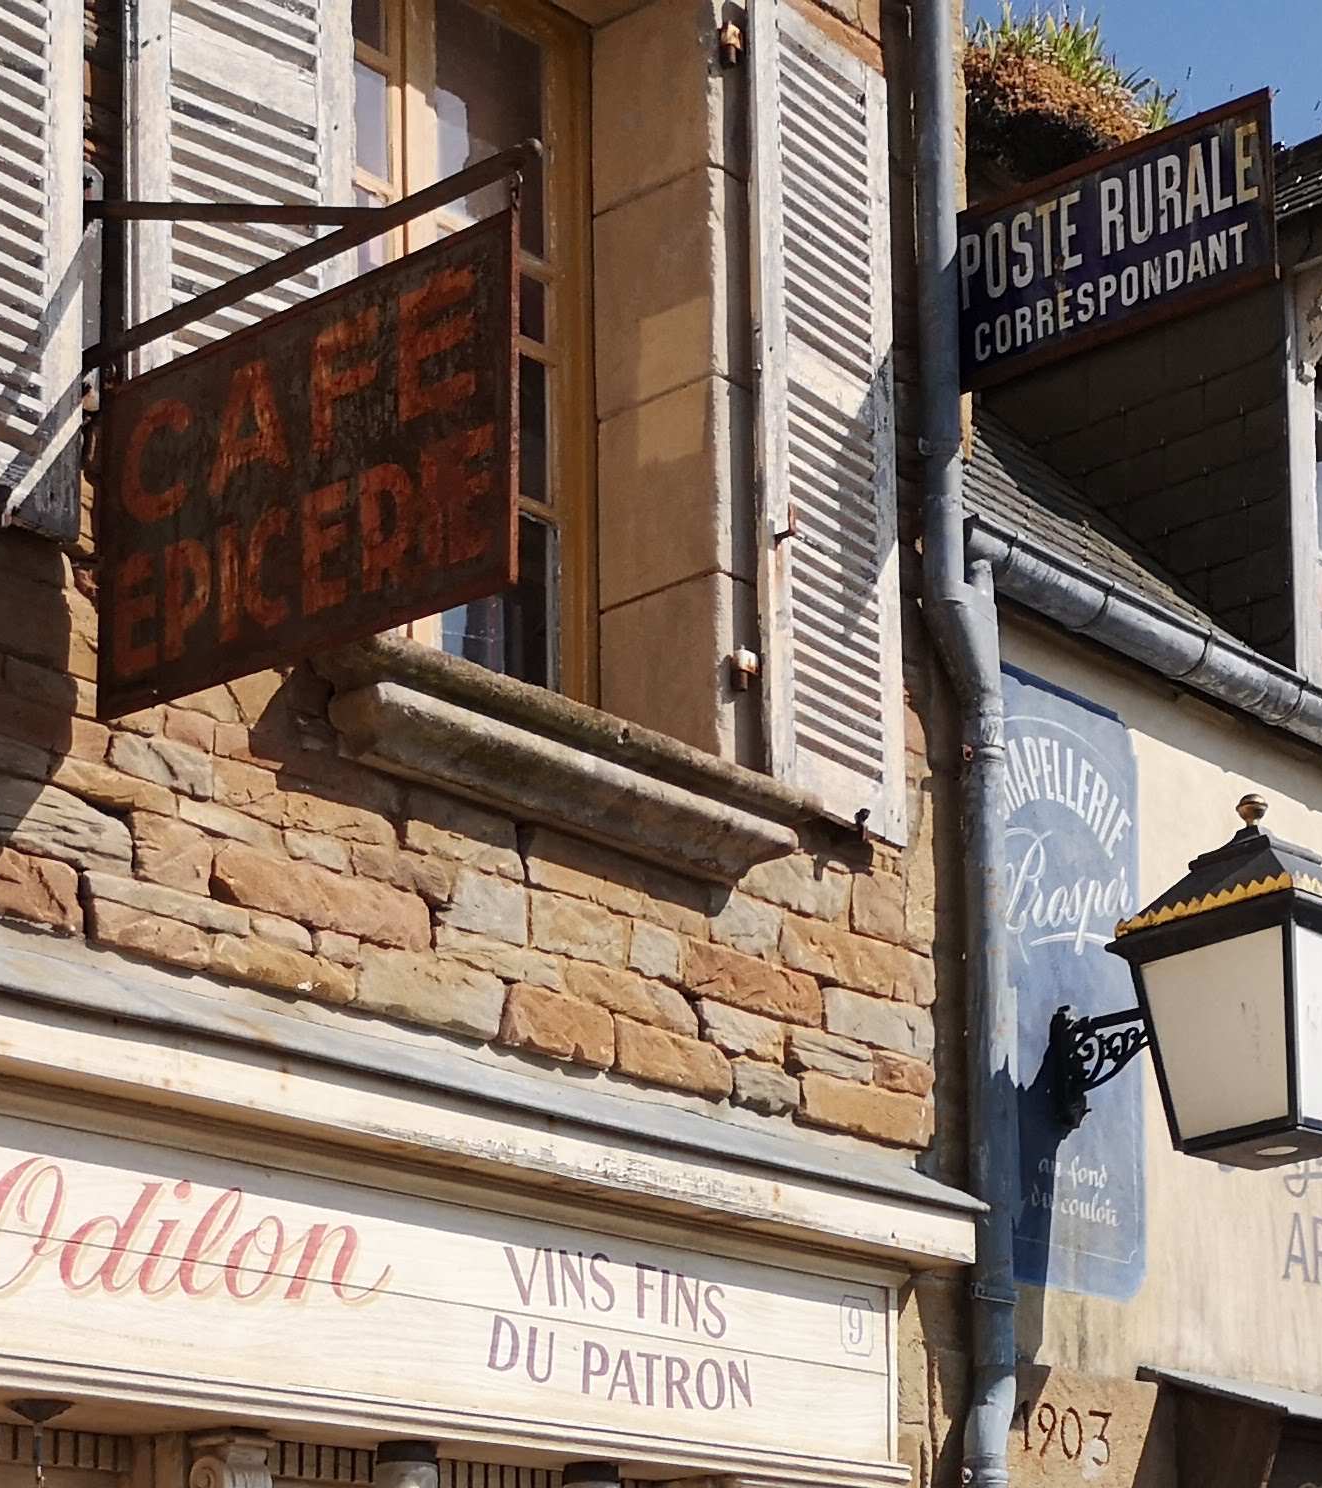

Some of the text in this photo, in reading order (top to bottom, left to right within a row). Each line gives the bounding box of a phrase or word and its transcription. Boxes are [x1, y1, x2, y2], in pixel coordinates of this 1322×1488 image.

[960, 121, 1259, 310] POSTE RURALE
[975, 222, 1248, 361] CORRESPONDANT
[997, 736, 1132, 859] HAPELLERIE
[1068, 1156, 1108, 1189] fond
[503, 1246, 728, 1340] VINS FINS
[846, 1306, 865, 1346] 9
[488, 1314, 754, 1411] DU PATRON
[1014, 1400, 1112, 1466] 1903
